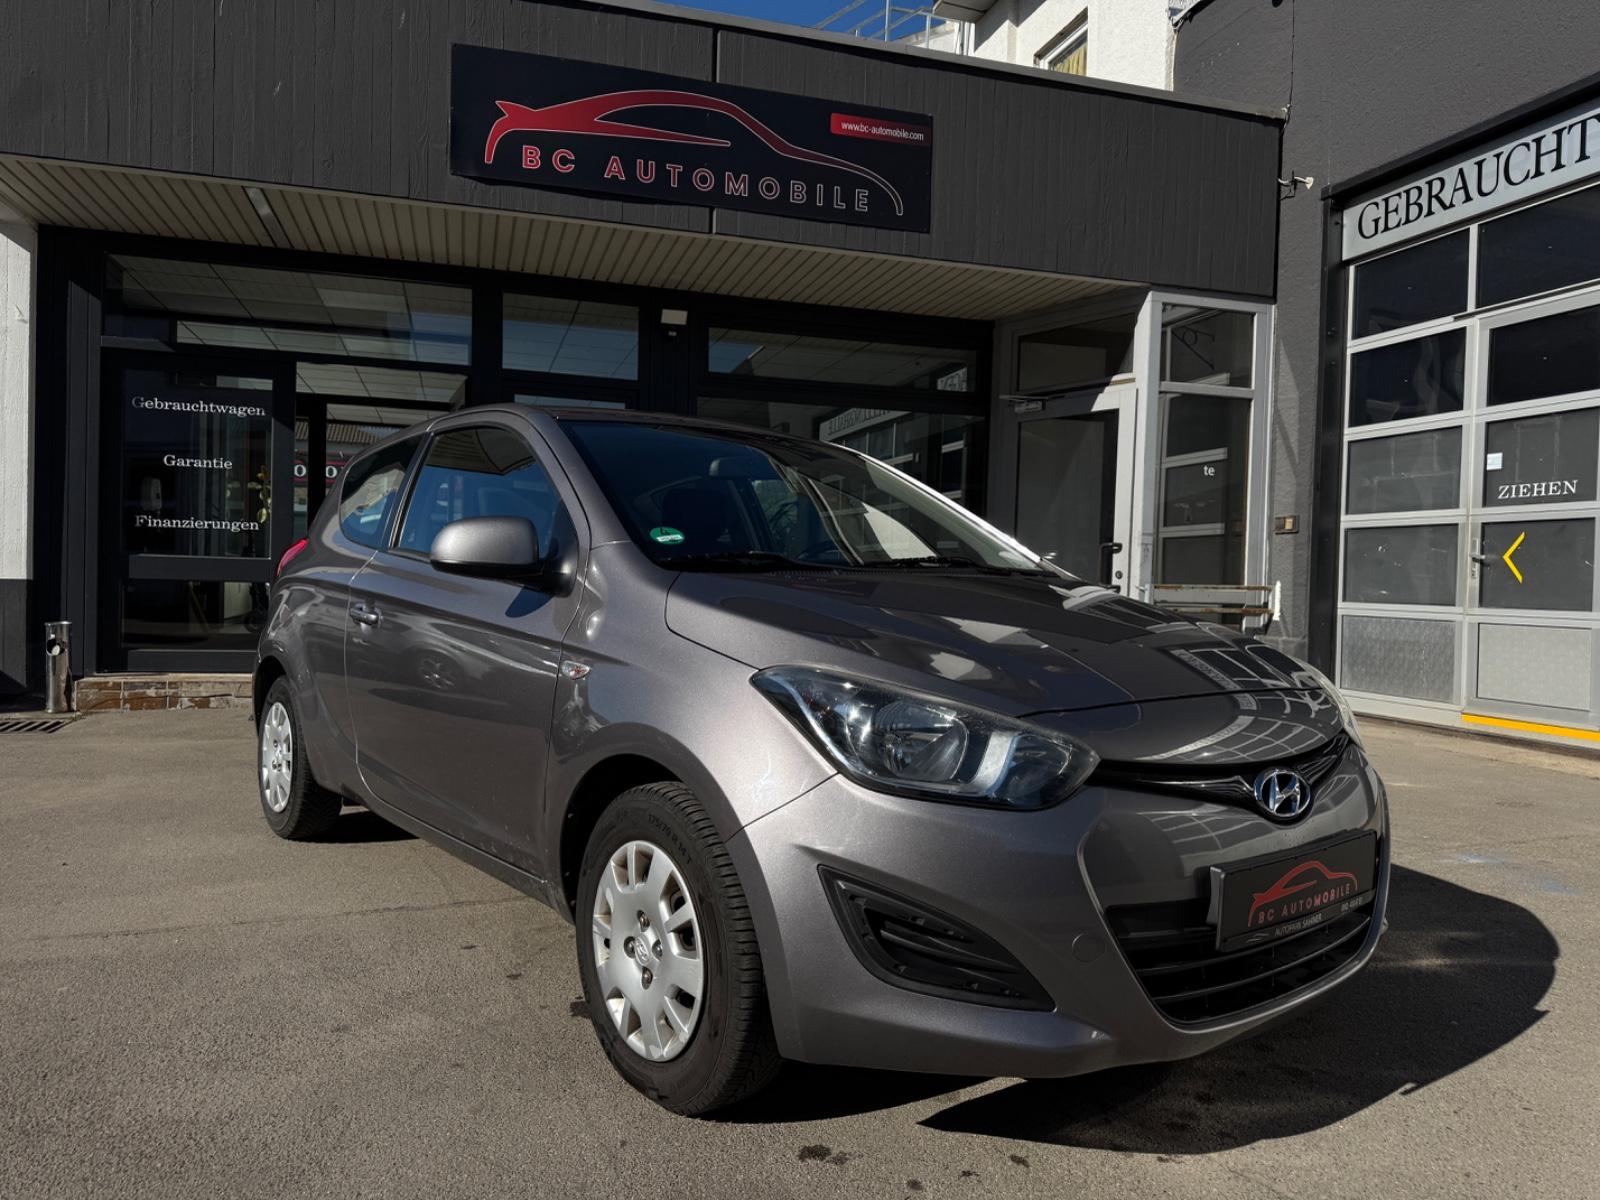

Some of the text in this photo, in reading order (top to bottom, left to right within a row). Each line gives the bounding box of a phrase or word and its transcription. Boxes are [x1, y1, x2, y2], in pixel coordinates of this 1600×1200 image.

[840, 121, 924, 141] www.bc-automobile.com
[521, 144, 870, 213] BC AUTOMOBILE
[1357, 114, 1600, 239] GEBRAUCHT
[132, 396, 266, 417] Gebrauchtwagen
[163, 454, 234, 470] Garantie
[1497, 479, 1579, 500] ZIEHEN
[134, 514, 260, 532] Finanzierungen
[1258, 910, 1275, 925] BC
[1281, 883, 1351, 917] AUTOMOBILE
